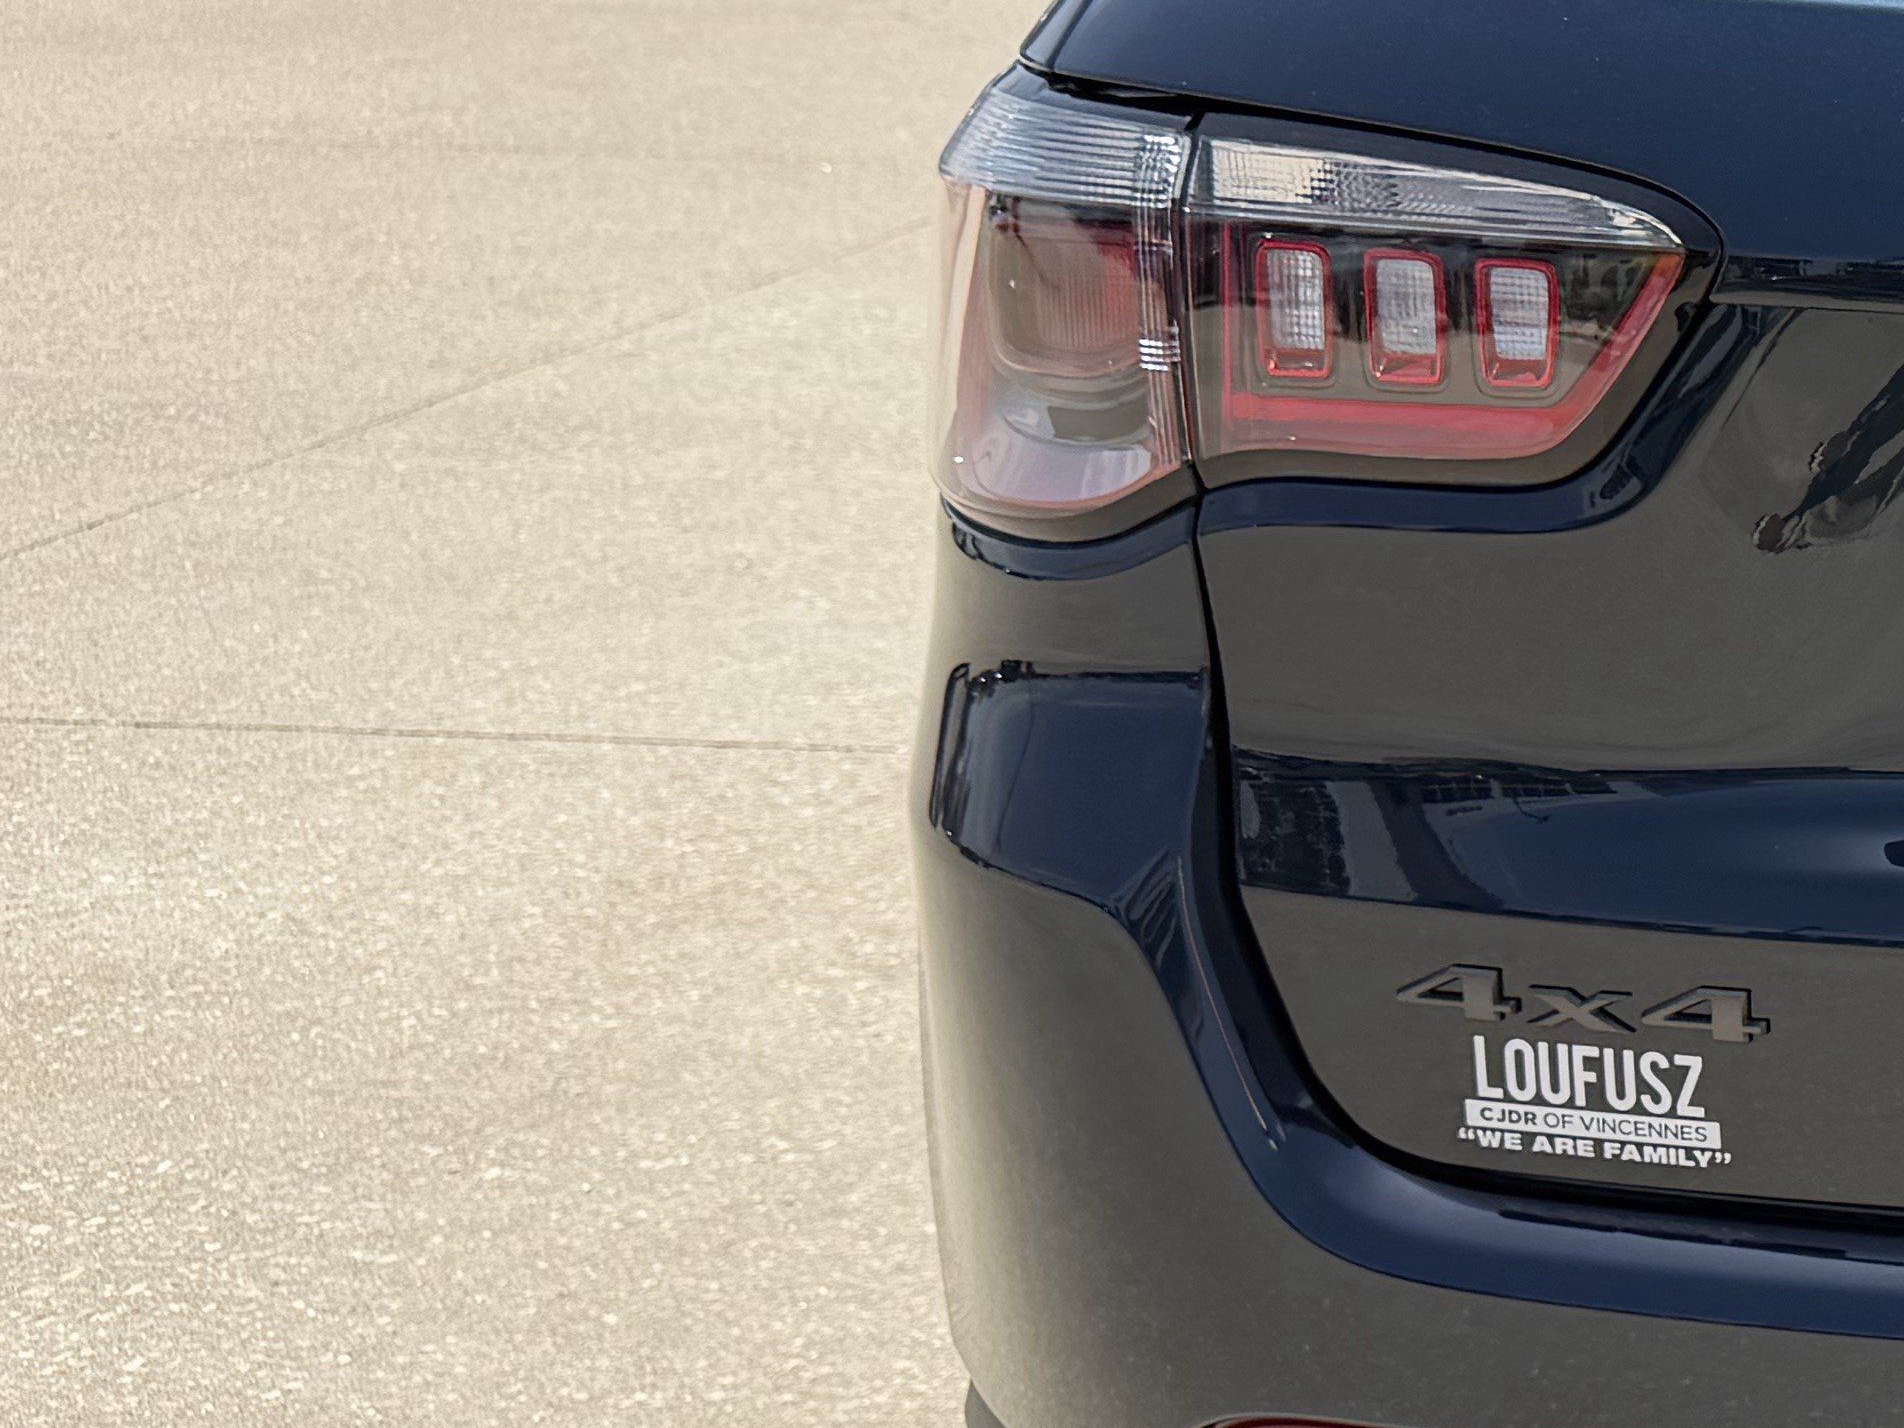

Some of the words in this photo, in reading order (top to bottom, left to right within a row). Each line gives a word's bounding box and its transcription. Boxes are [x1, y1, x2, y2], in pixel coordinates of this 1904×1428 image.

[1479, 1106, 1538, 1126] CJDR
[1543, 1112, 1575, 1130] OF
[1578, 1115, 1708, 1143] VINCENNES
[1532, 1135, 1596, 1159] ARE
